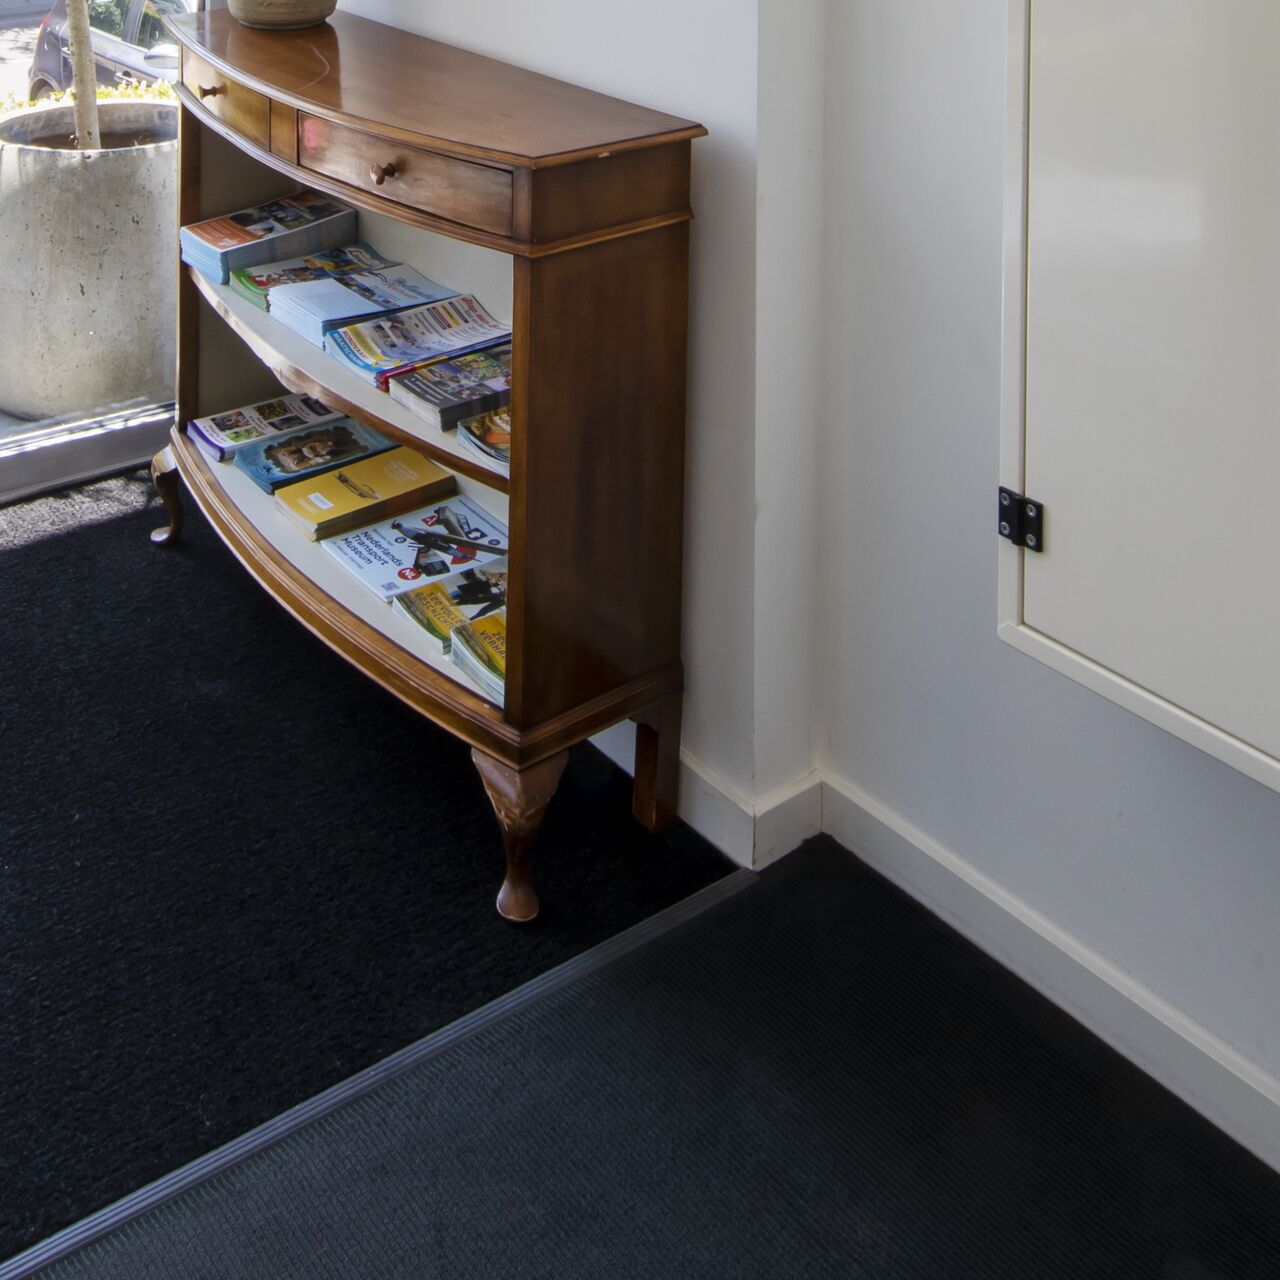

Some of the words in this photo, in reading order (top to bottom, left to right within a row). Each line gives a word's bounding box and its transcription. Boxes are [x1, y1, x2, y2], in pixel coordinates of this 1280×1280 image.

[341, 537, 373, 565] Museum
[352, 534, 389, 566] Transport
[361, 531, 404, 567] Nederlands
[401, 568, 416, 580] NL
